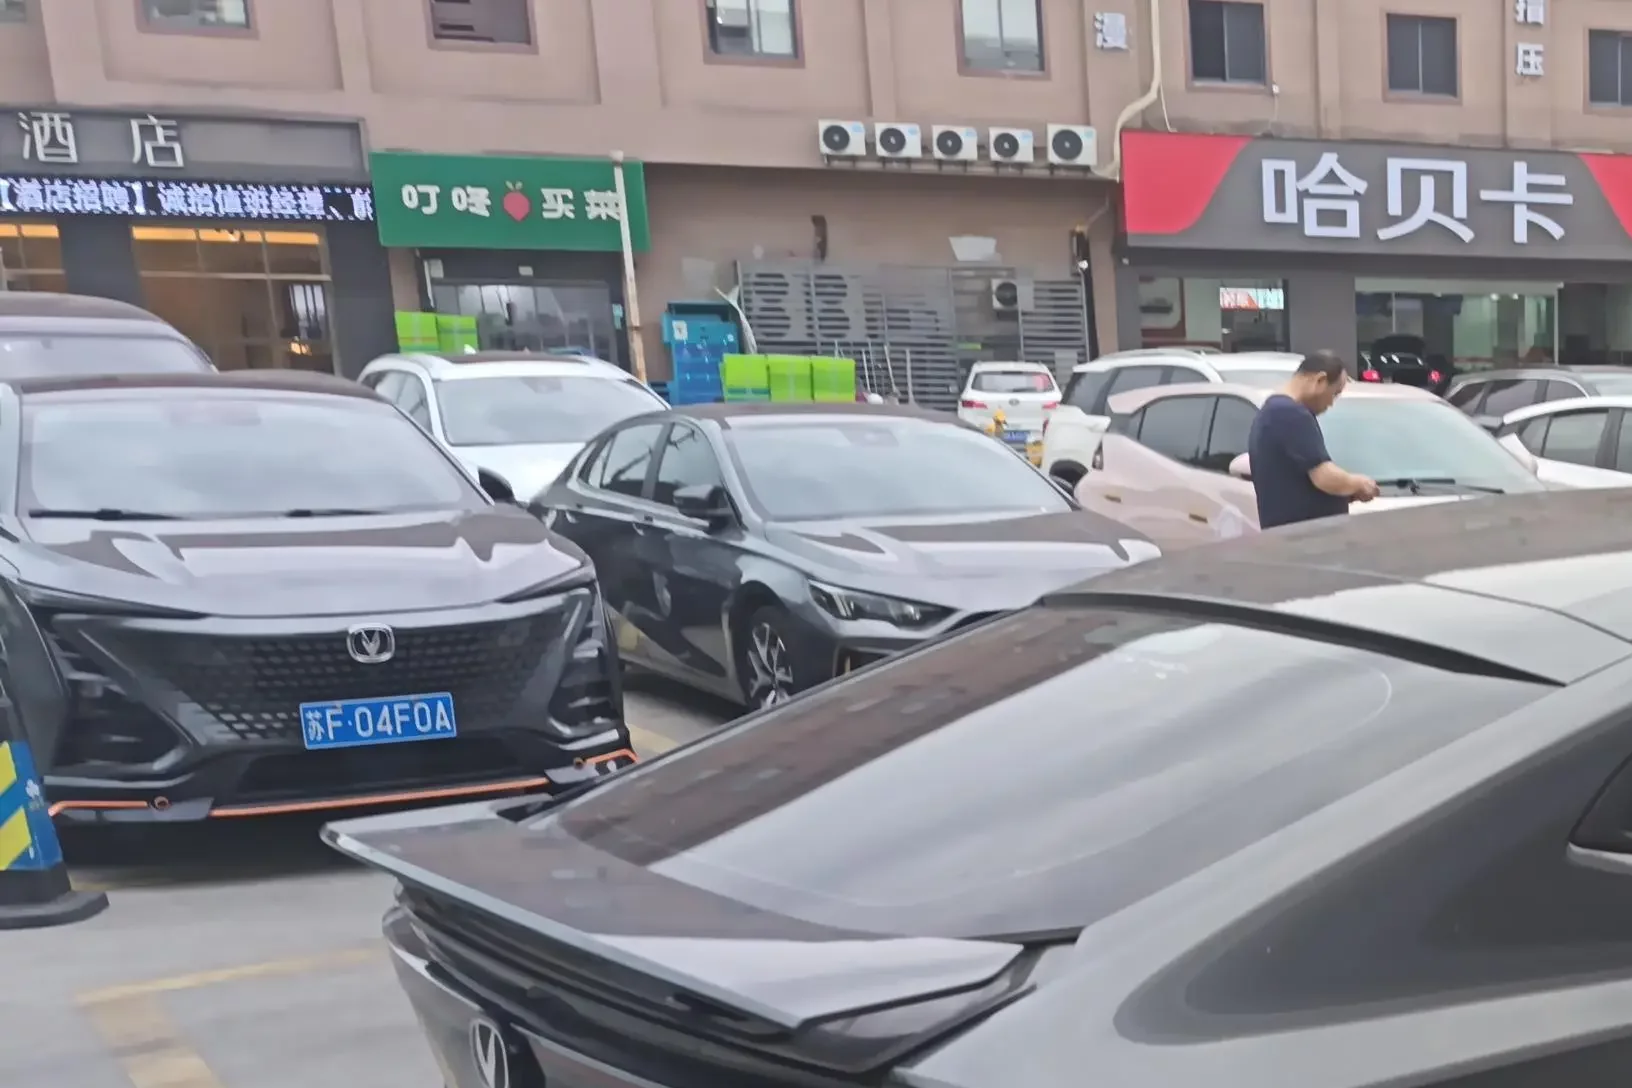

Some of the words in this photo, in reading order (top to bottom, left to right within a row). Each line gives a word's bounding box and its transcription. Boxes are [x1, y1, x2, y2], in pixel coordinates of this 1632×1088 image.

[19, 112, 185, 168] 酒店
[1261, 151, 1574, 244] 哈贝卡
